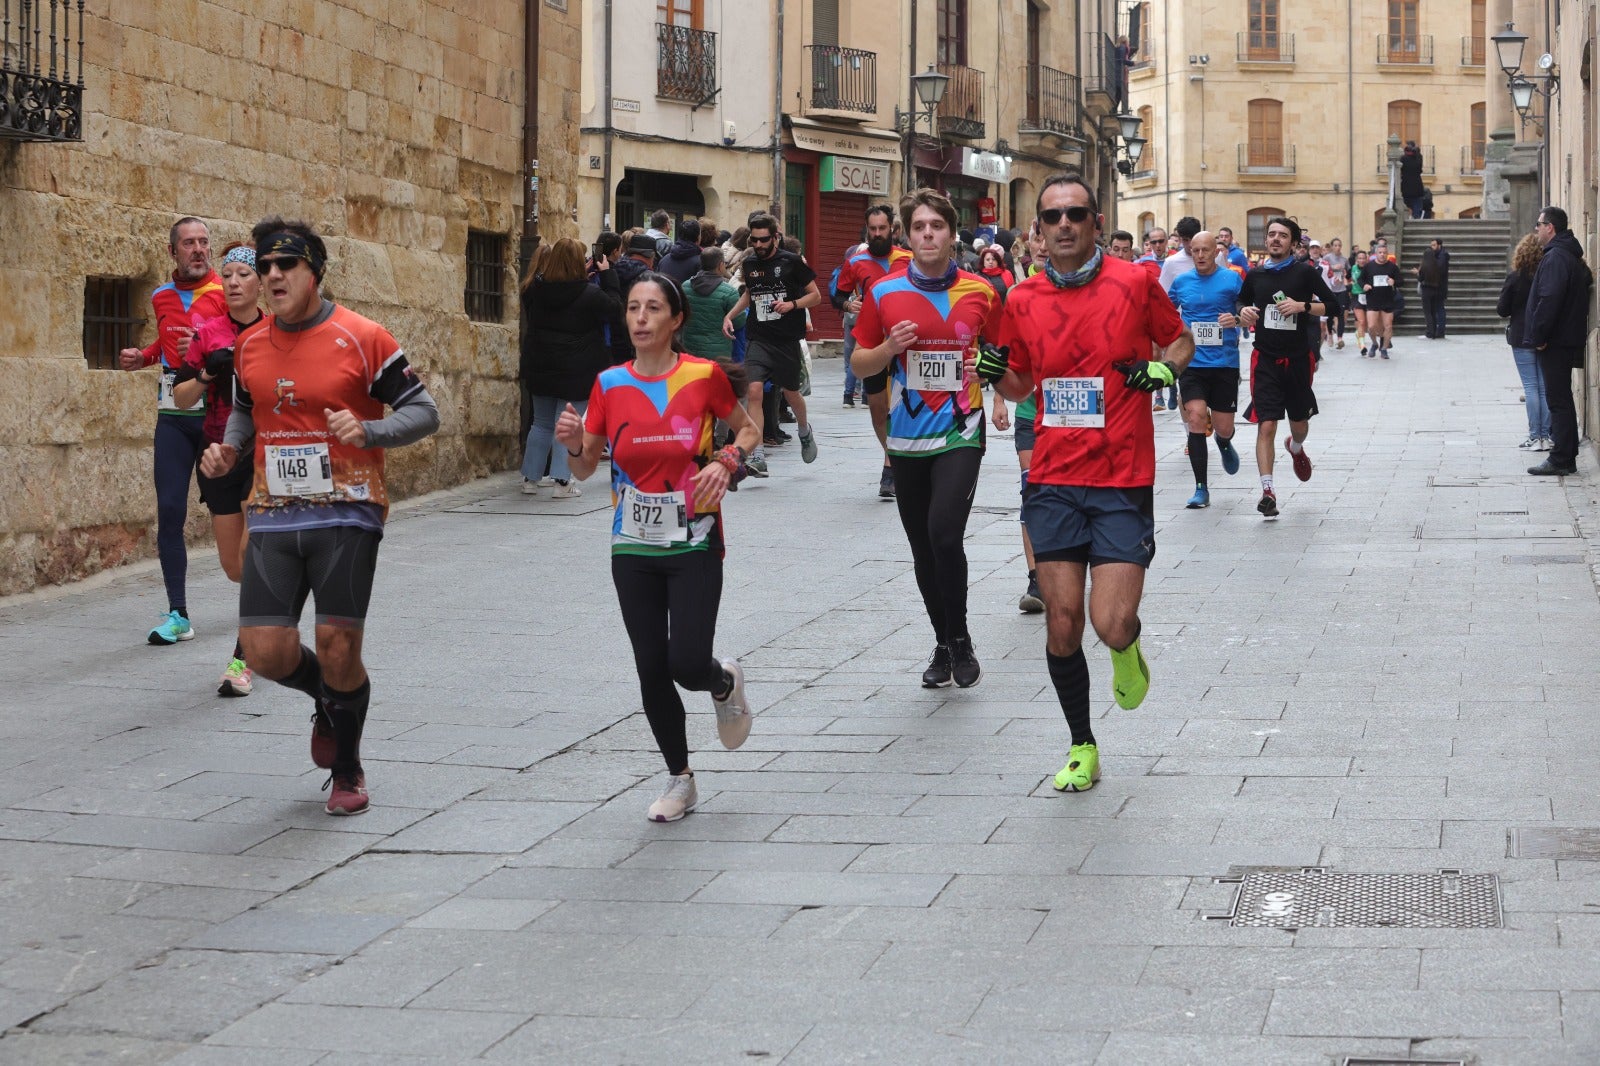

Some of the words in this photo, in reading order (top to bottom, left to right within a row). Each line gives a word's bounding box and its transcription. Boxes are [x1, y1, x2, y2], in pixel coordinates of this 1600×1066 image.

[809, 137, 825, 148] away
[841, 165, 881, 191] SCALE
[1197, 327, 1213, 338] 508
[922, 353, 958, 361] SETEL
[919, 361, 946, 378] 1201
[1057, 380, 1098, 389] SETEL
[1050, 390, 1089, 411] 3638
[280, 446, 321, 457] SETEL
[277, 458, 308, 479] 1148
[635, 494, 679, 505] SETEL
[633, 503, 663, 525] 872
